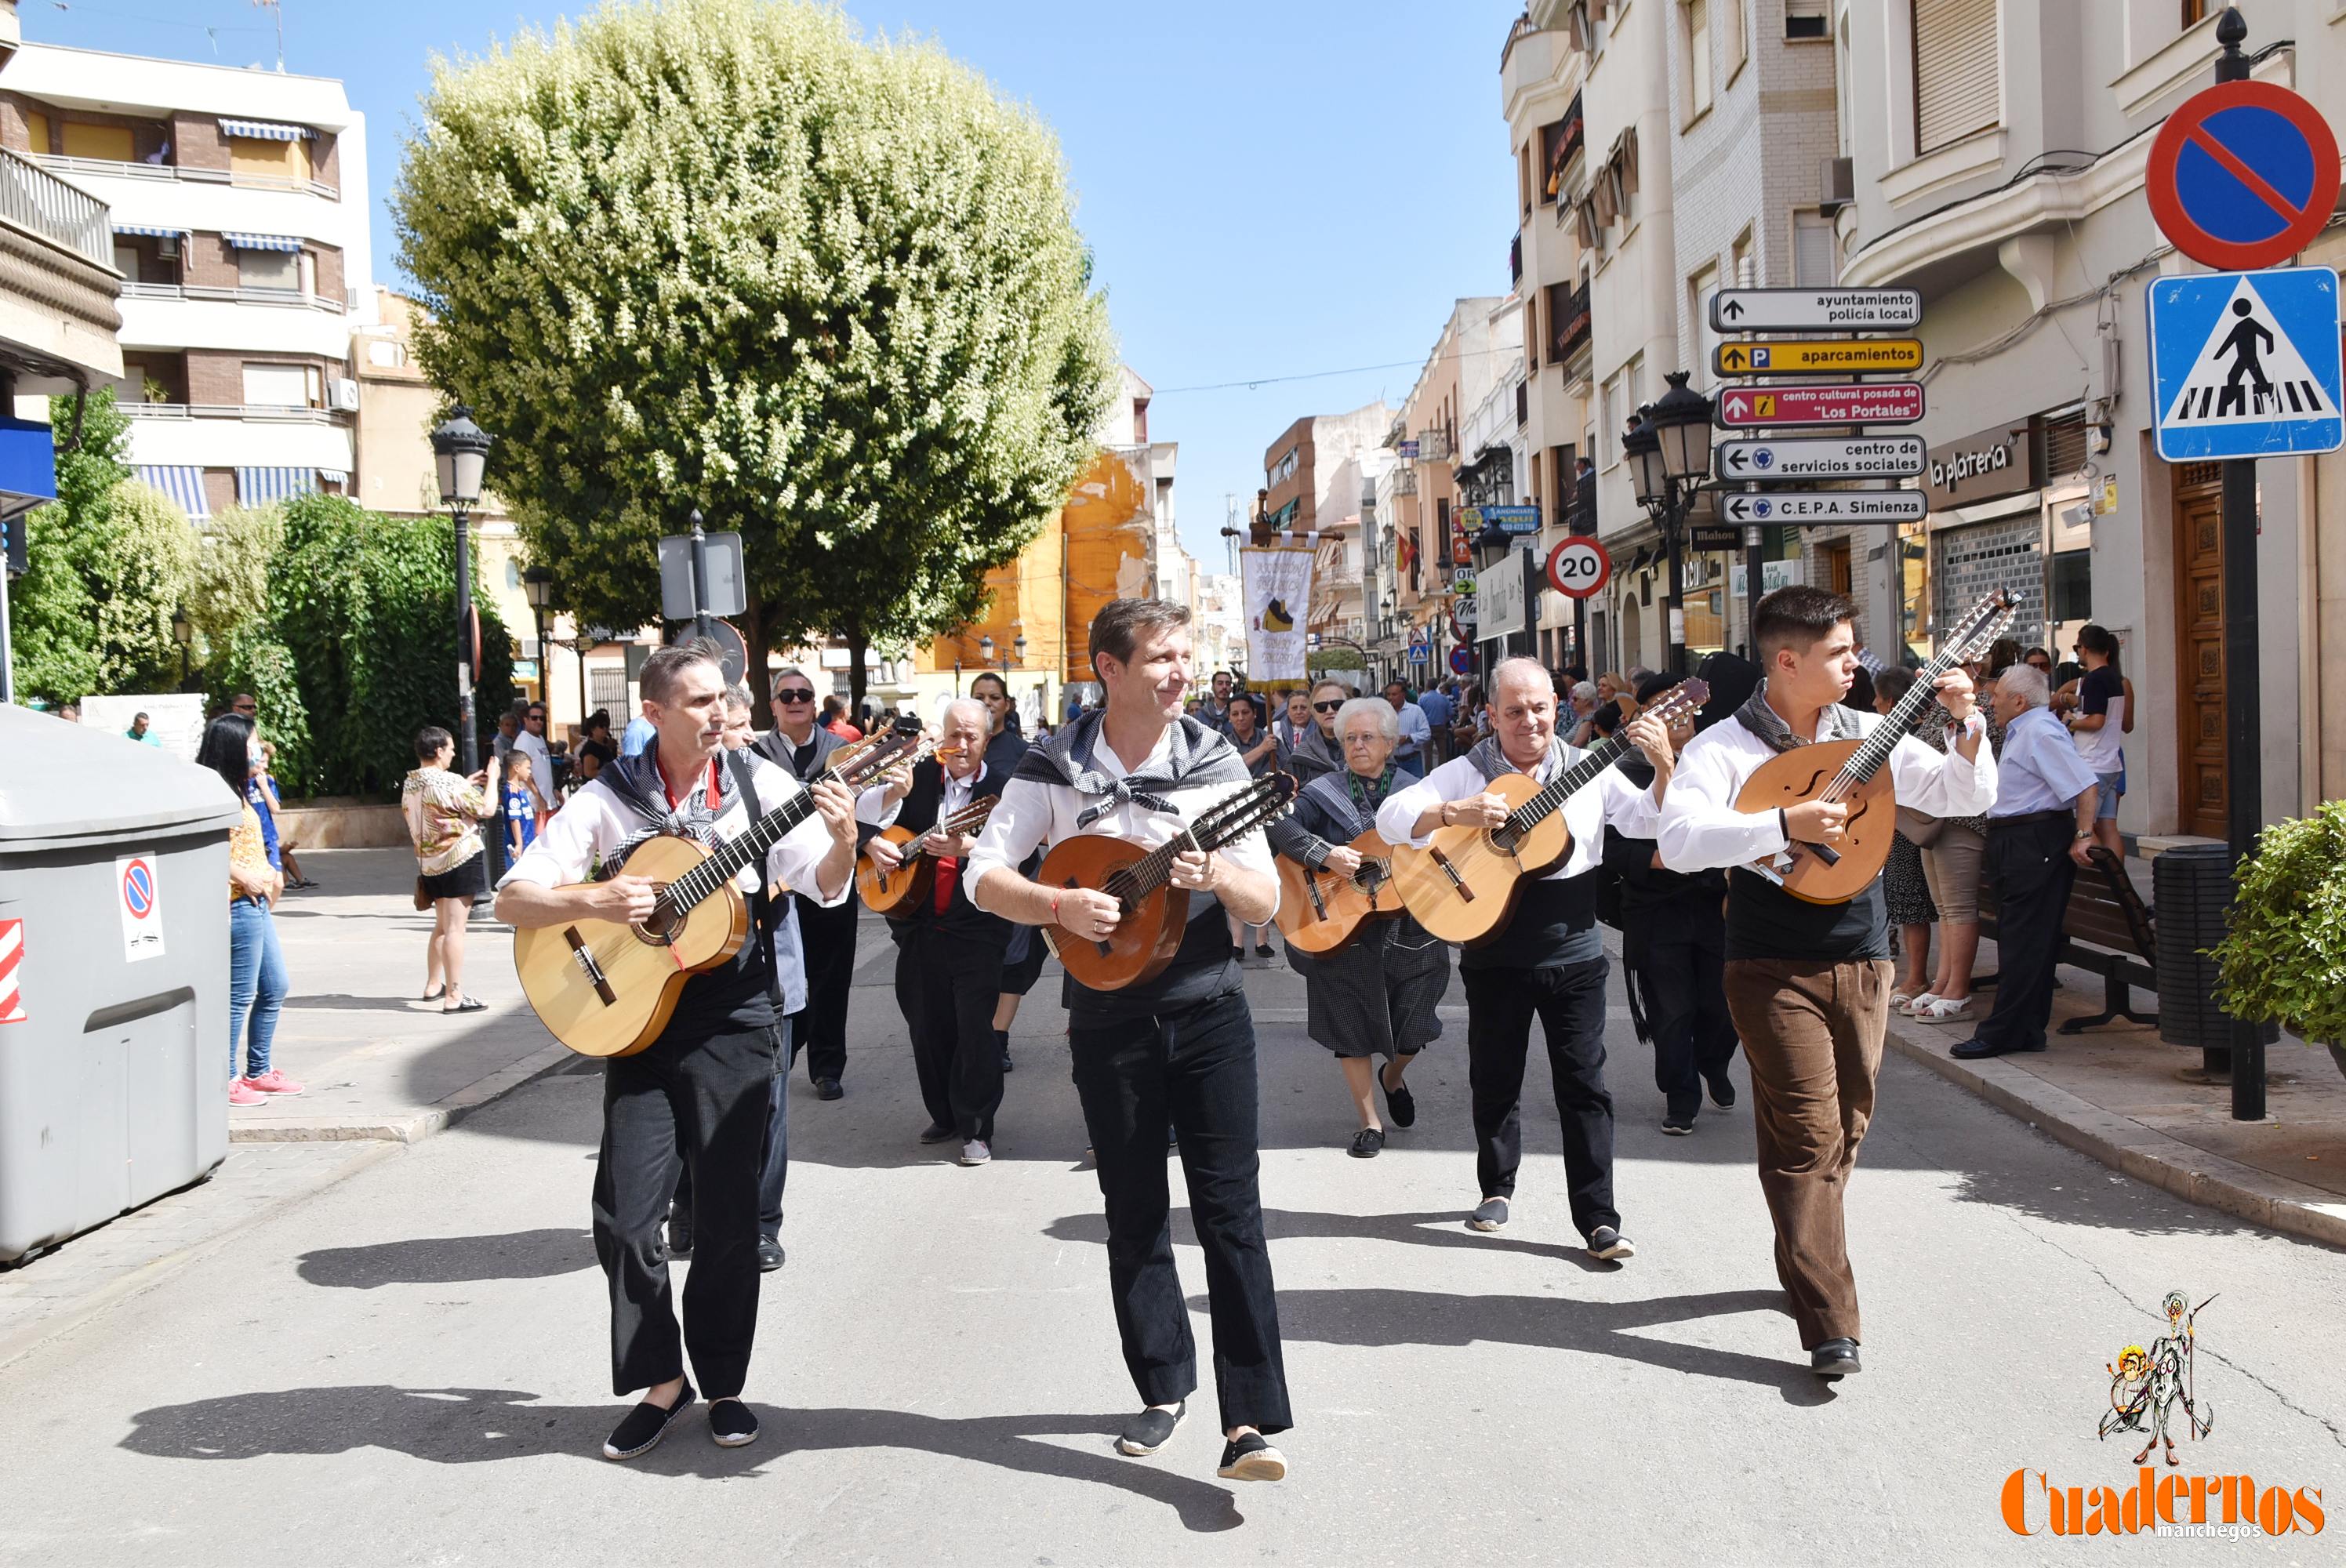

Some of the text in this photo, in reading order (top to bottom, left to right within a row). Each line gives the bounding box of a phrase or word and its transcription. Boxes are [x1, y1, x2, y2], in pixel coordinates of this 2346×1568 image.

[1817, 294, 1913, 307] ayuntamiento
[1828, 307, 1914, 322] policía local
[1753, 349, 1915, 365] P aparcamientos
[1782, 388, 1917, 401] centro cultural posada de
[1846, 442, 1918, 456] centro de
[1781, 457, 1918, 473] servicios sociales
[1930, 459, 1944, 487] la
[1781, 499, 1919, 515] C.E.P.A. Simienza
[1697, 531, 1735, 541] Mahou
[1561, 556, 1596, 578] 20
